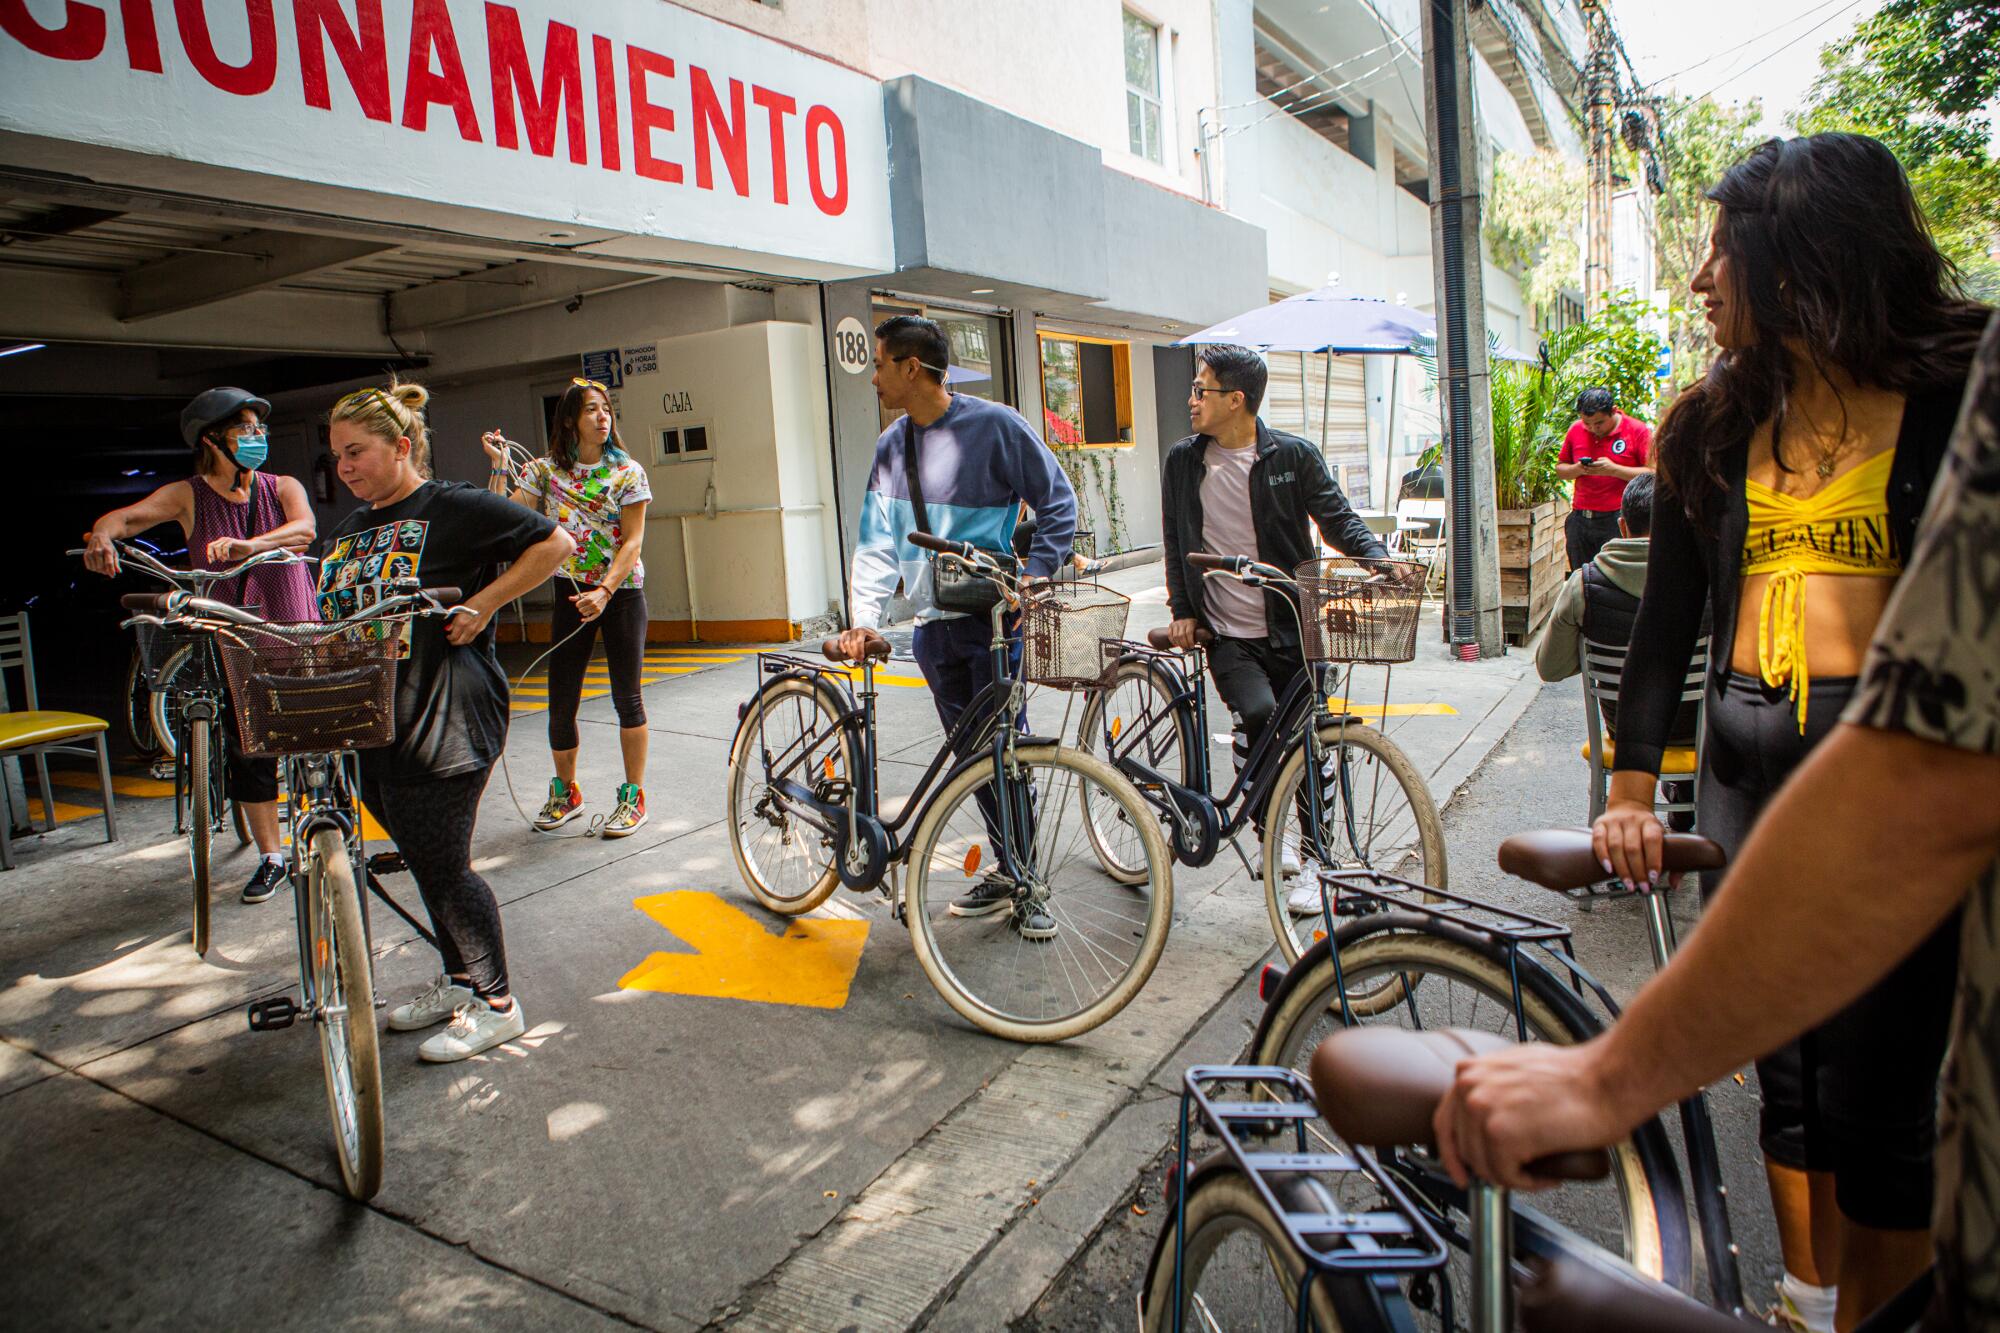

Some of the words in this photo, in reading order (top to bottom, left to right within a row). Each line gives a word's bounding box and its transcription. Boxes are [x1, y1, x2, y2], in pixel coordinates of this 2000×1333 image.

[635, 354, 657, 364] HORAS
[836, 331, 868, 365] 188
[663, 391, 693, 414] CAJA
